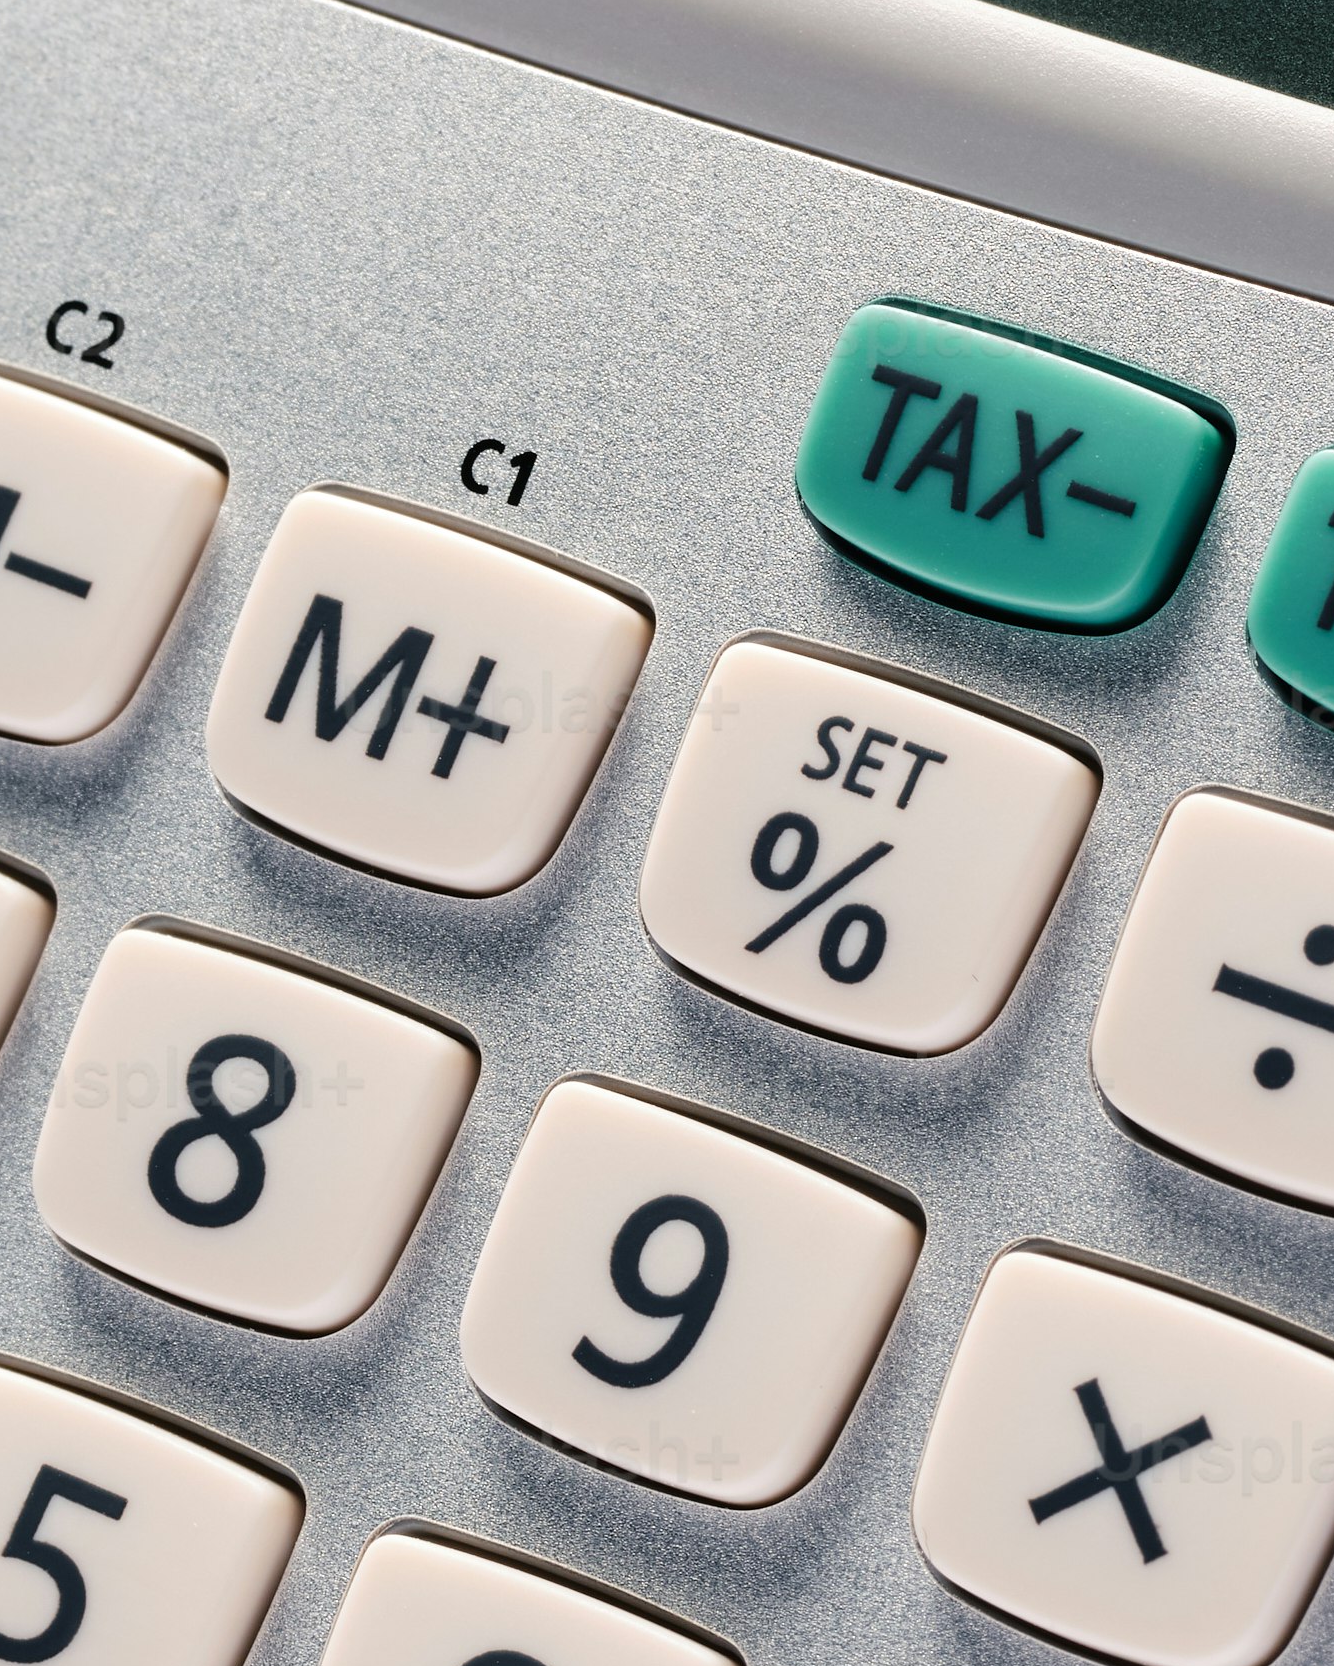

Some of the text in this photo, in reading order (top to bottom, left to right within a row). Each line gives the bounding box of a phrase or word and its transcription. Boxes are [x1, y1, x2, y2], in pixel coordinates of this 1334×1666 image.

[46, 300, 125, 369] C2
[460, 439, 537, 506] C1
[265, 594, 510, 779] M+
[801, 716, 947, 810] SET
[745, 812, 894, 984] %
[147, 1034, 296, 1228] 8
[572, 1195, 729, 1389] 9
